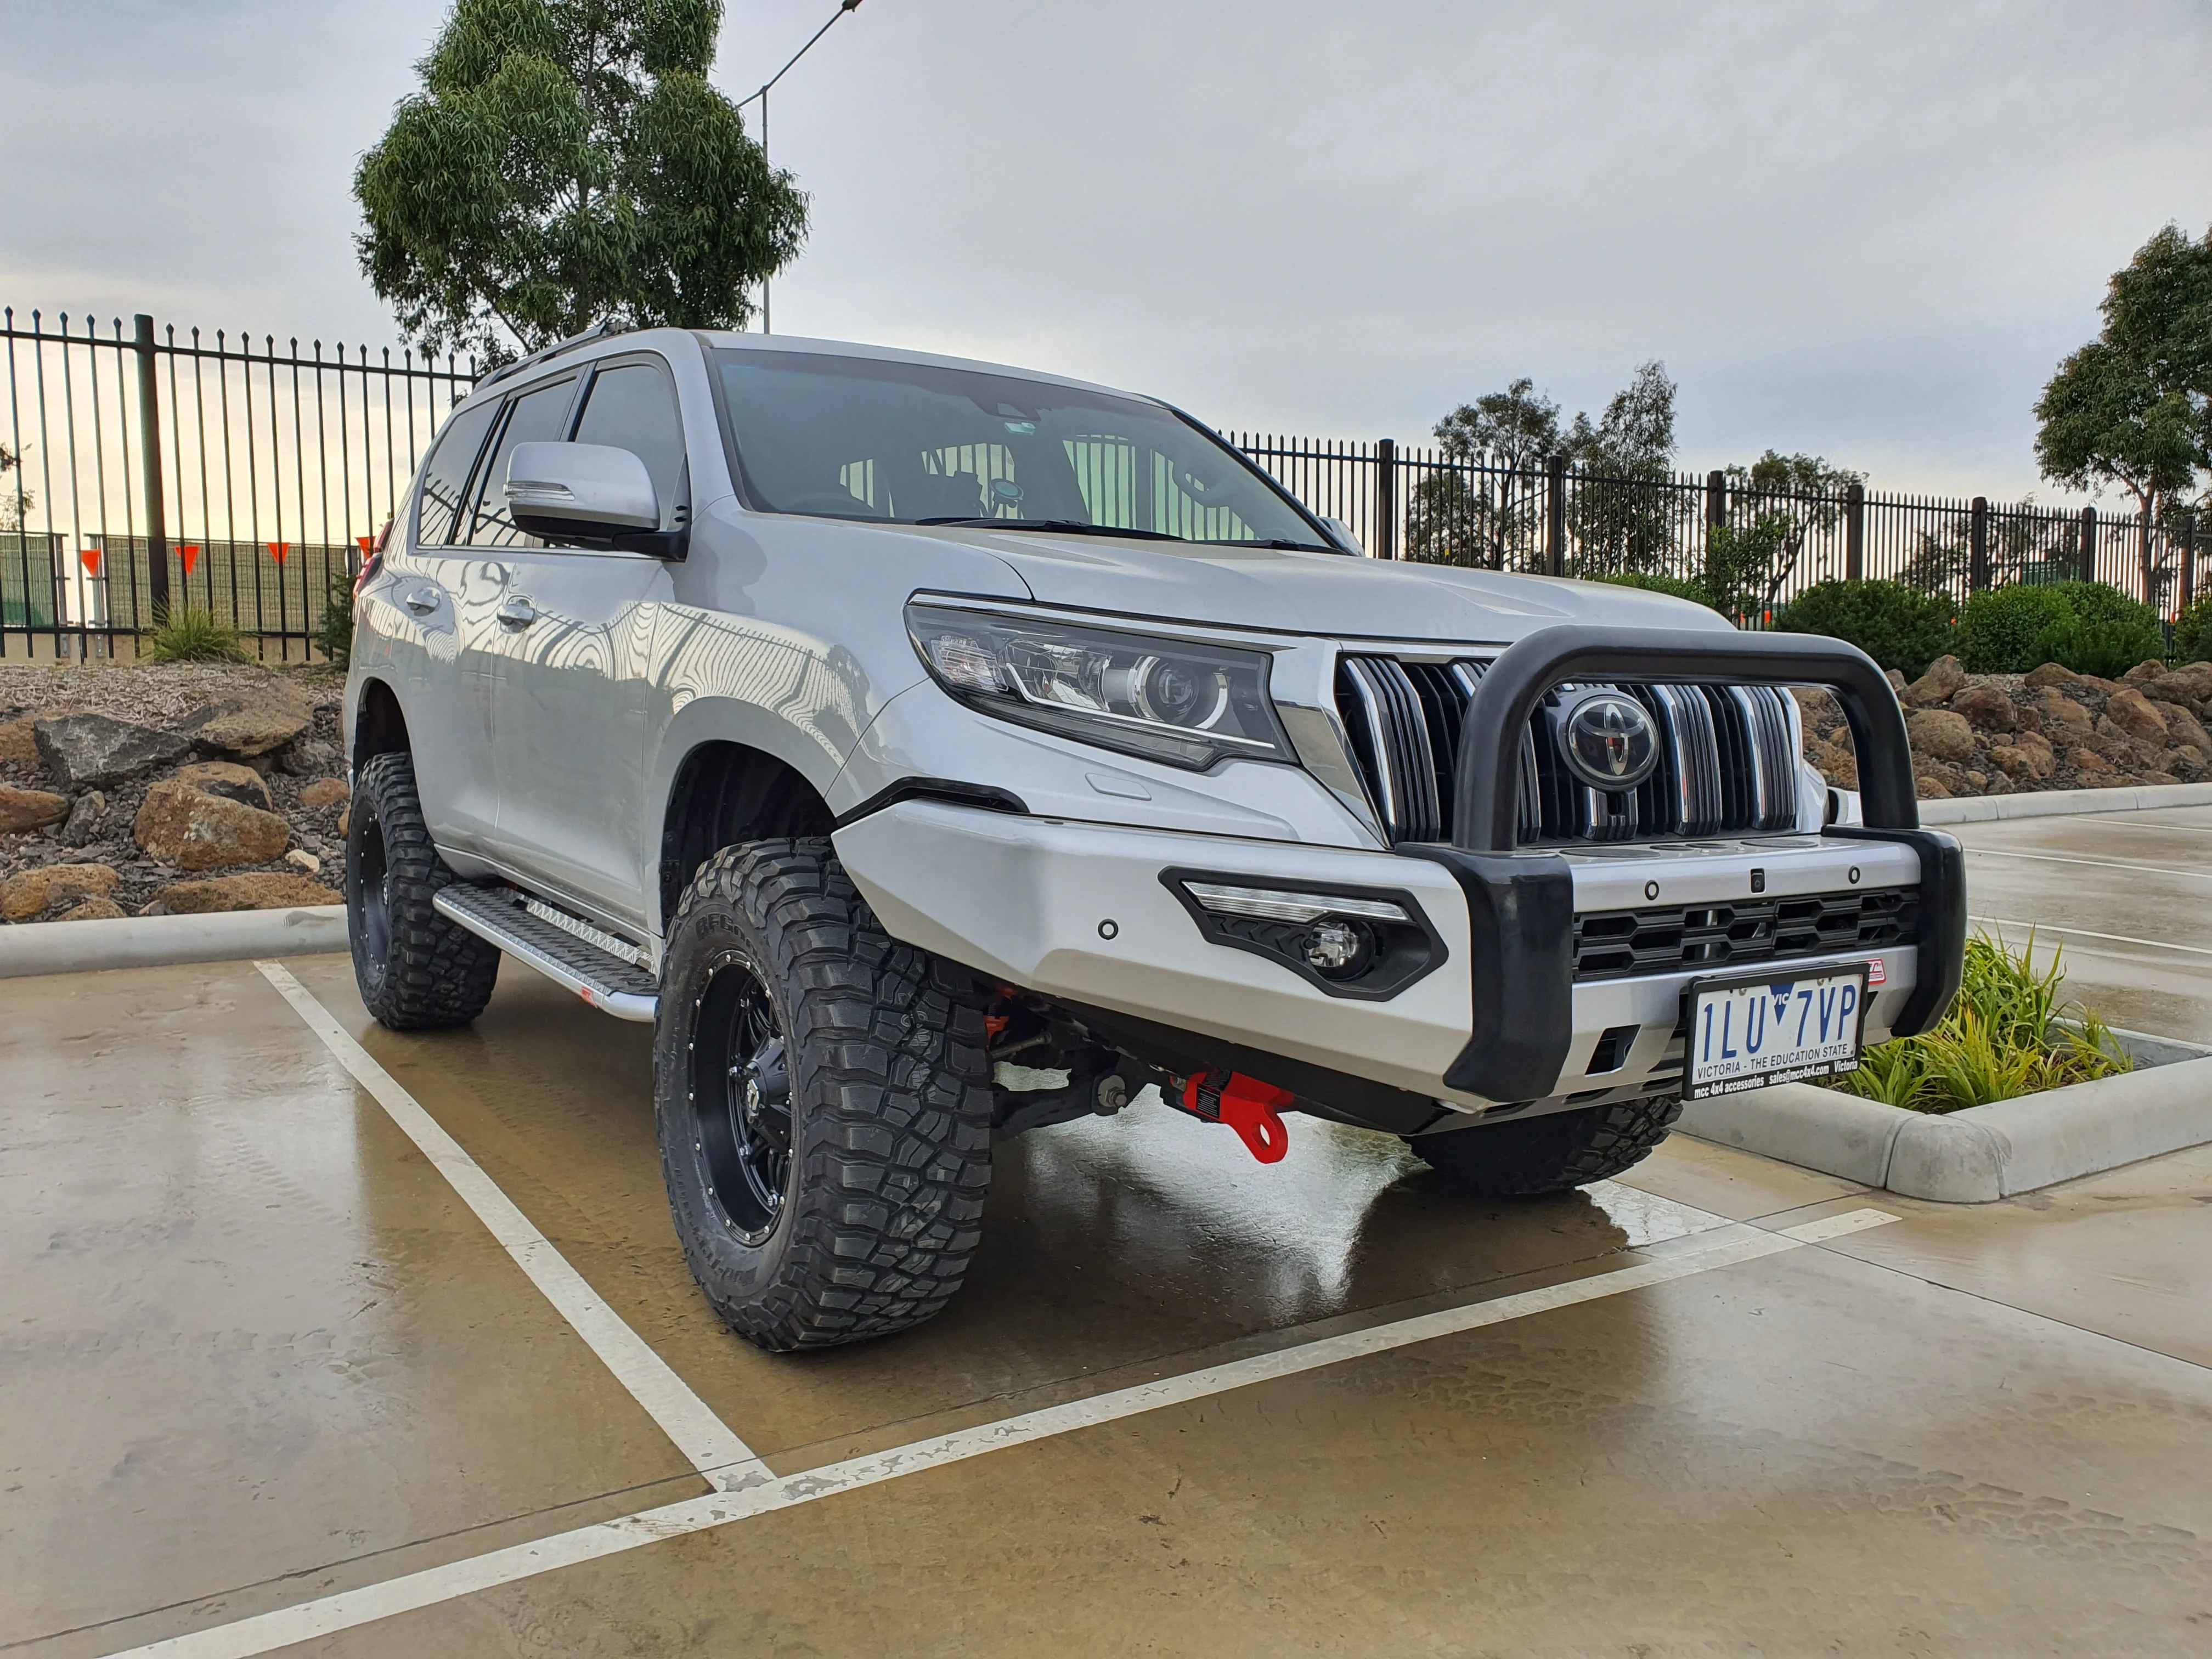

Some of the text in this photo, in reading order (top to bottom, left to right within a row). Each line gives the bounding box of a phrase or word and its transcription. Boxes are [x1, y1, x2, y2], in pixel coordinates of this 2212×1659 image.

[1773, 993, 1789, 1005] VIC
[1703, 985, 1856, 1062] 1LU 7VP
[1694, 1058, 1858, 1099] mcc 4x4 accessories sales@mcc4x4.com Victoria
[1698, 1062, 1740, 1079] VICTORIA
[1751, 1057, 1768, 1070] THE
[1770, 1048, 1820, 1066] EDUCATION
[1822, 1043, 1847, 1058] STATE
